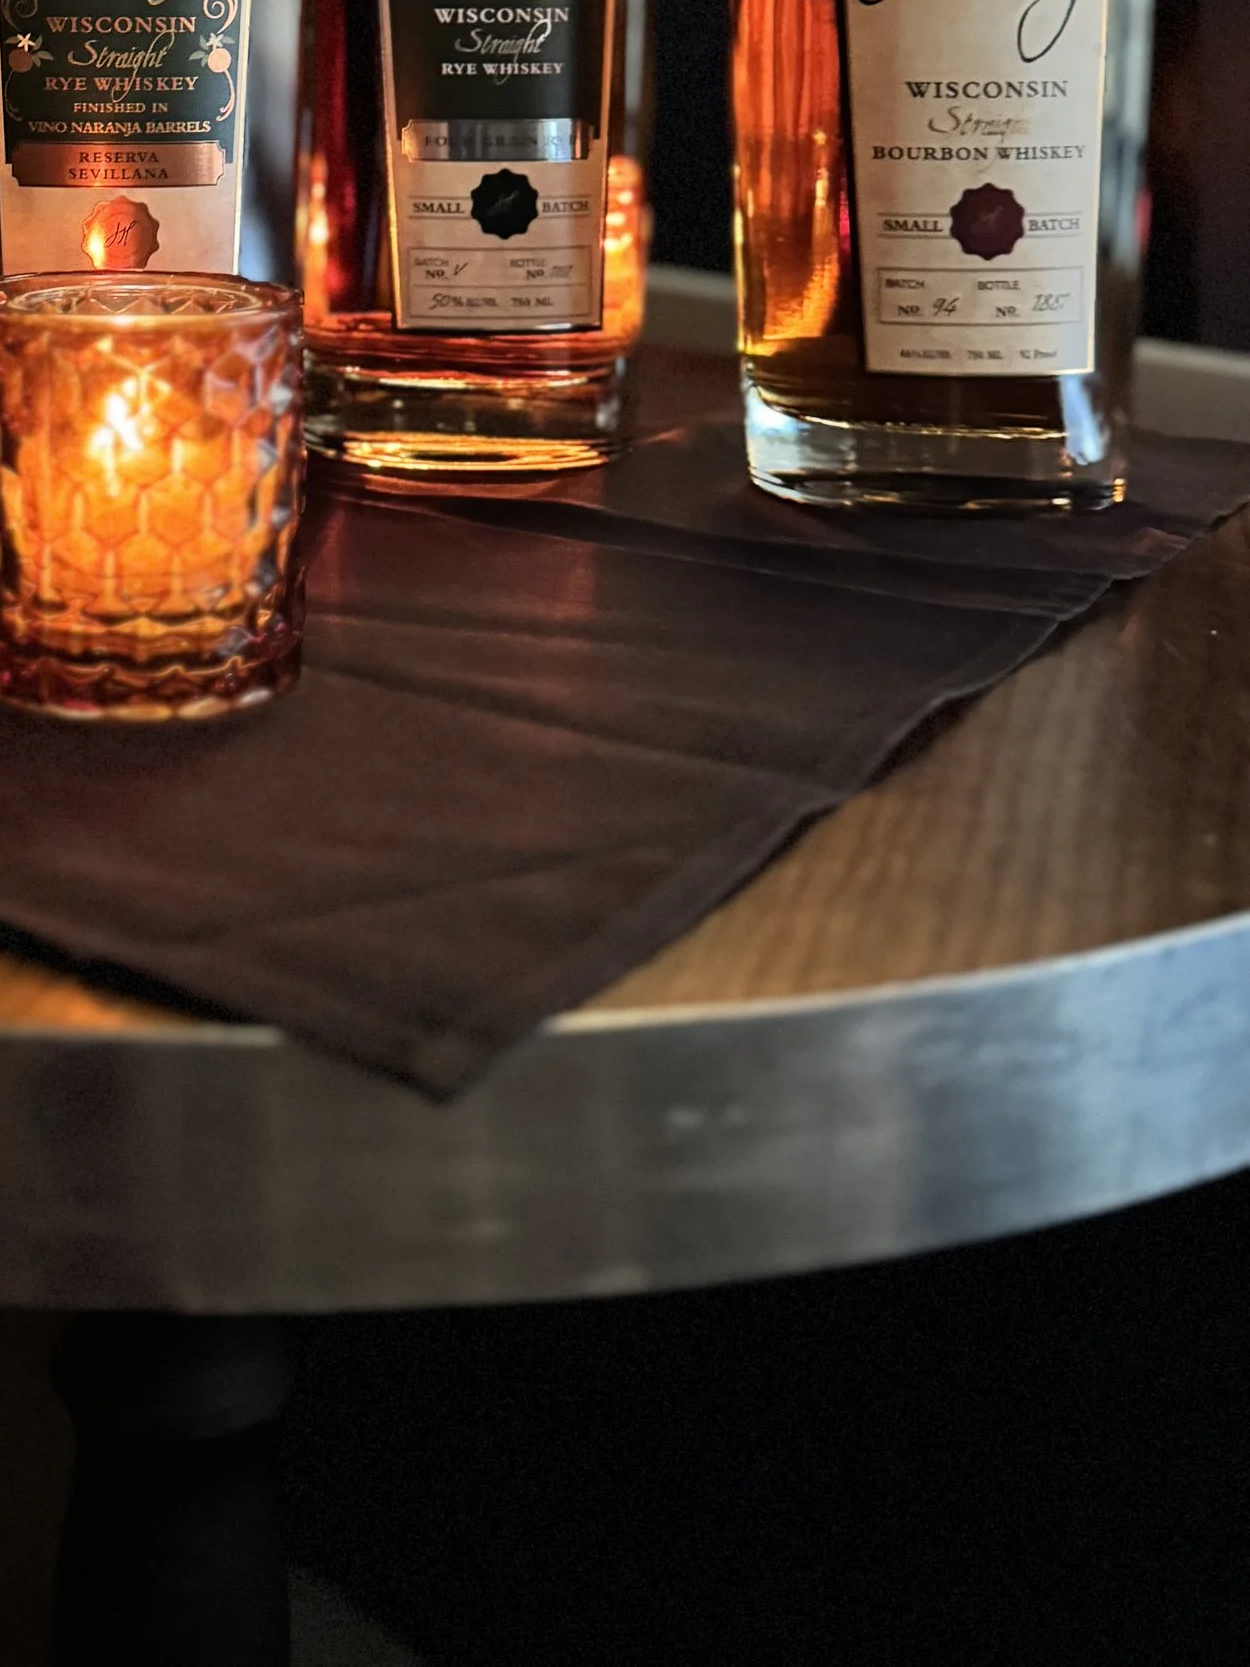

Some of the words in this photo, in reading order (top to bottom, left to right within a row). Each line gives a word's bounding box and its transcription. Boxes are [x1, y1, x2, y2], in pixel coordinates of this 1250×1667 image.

[434, 7, 571, 24] WISCONSIN
[45, 16, 197, 34] WISCONSIN
[454, 18, 552, 85] Straight
[67, 28, 175, 103] Straight
[441, 62, 478, 75] RYE
[482, 62, 565, 75] WHISKEY
[44, 76, 87, 91] RYE
[94, 76, 199, 92] WHISKEY
[904, 79, 1070, 100] WISCONSIN
[73, 102, 146, 114] FINISHED
[152, 102, 169, 114] IN
[28, 121, 68, 134] VINO
[71, 121, 142, 137] NARANJA
[146, 120, 212, 134] BARRELS
[78, 151, 160, 164] RESERVA
[872, 145, 988, 161] BOURBON
[995, 145, 1086, 161] WHISKEY
[68, 167, 169, 181] SEVILLANA
[412, 202, 465, 215] SMALL
[541, 200, 588, 213] BATCH
[882, 219, 944, 233] SMALL
[1028, 218, 1081, 232] BATCH
